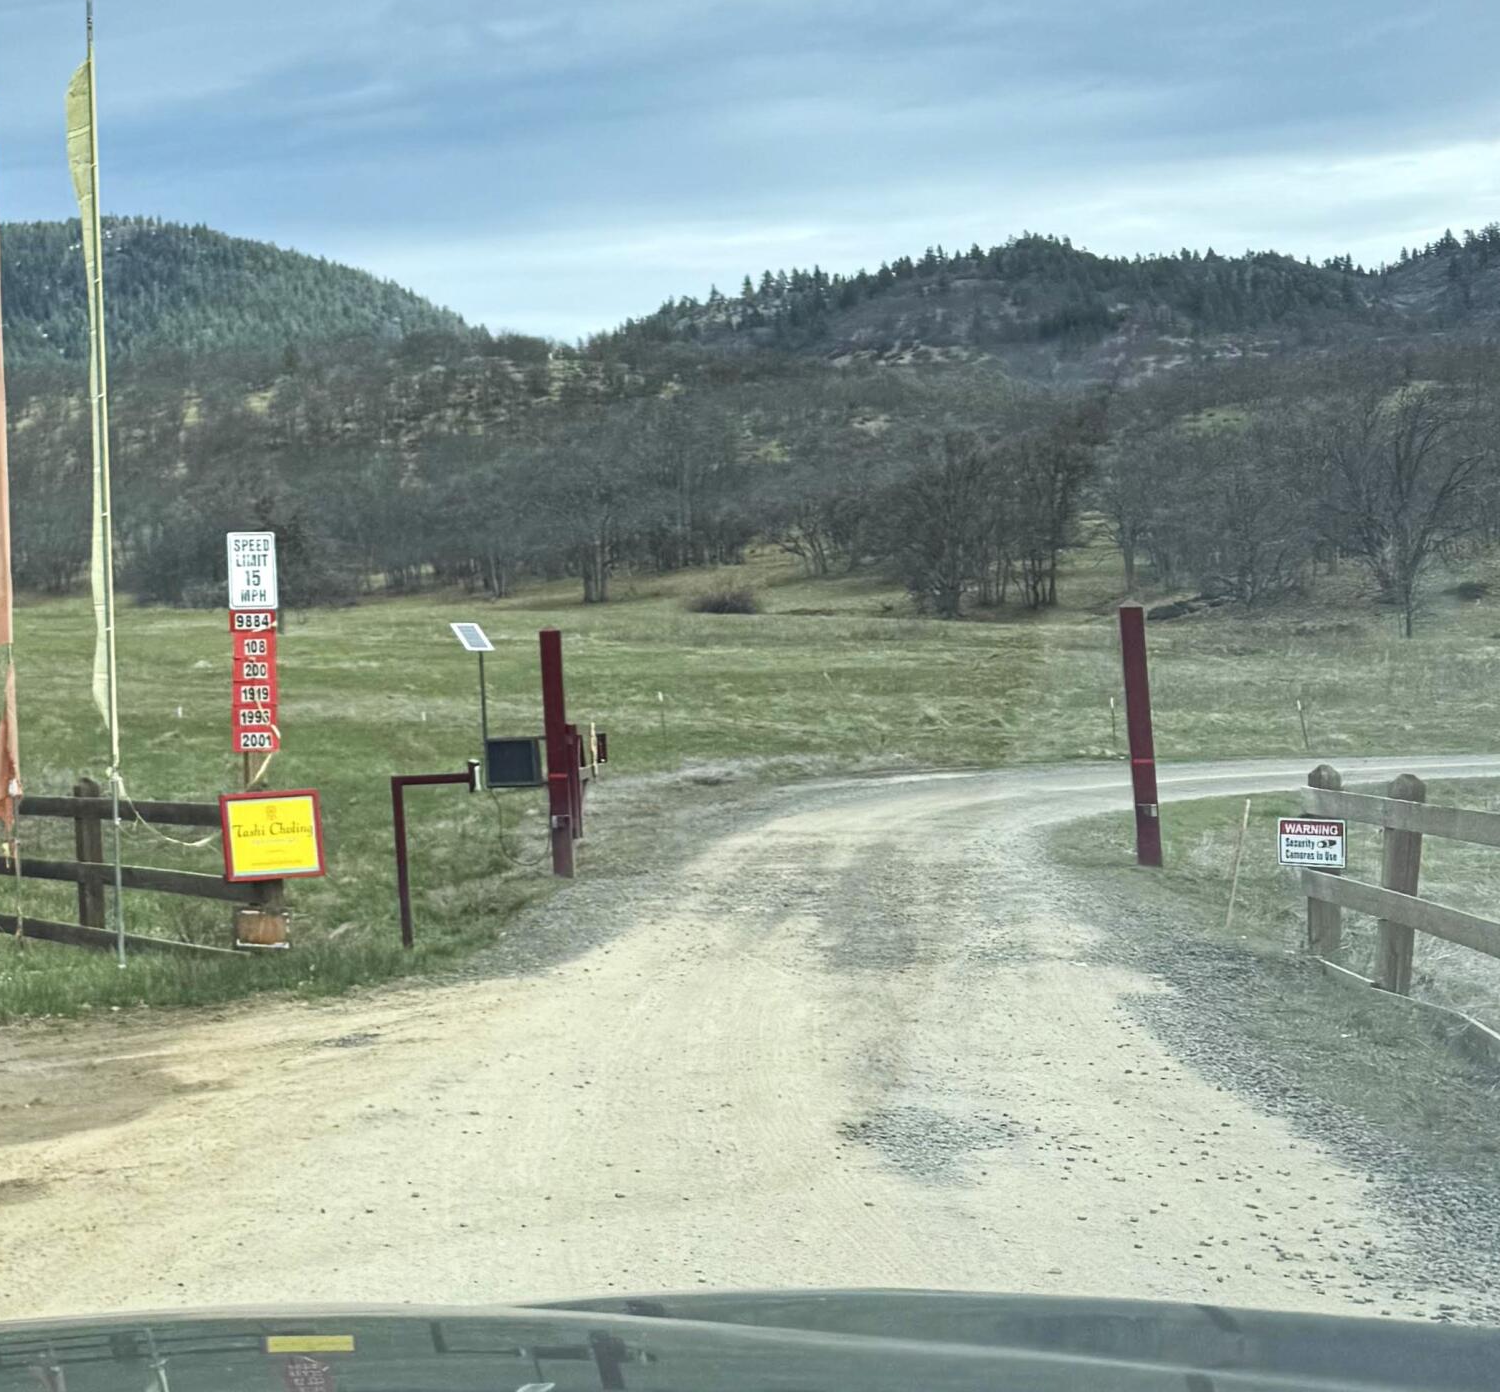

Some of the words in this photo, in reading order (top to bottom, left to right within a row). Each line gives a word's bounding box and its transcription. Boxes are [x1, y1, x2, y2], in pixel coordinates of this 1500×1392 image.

[233, 539, 270, 552] SPEED
[235, 554, 268, 567] LIMIT
[245, 570, 261, 586] 15
[241, 589, 267, 602] MPH
[236, 615, 269, 628] 9884
[245, 641, 266, 653] 108
[245, 664, 267, 677] 200
[242, 687, 269, 701] 1919
[242, 734, 272, 747] 2001
[232, 824, 265, 838] Tashi
[269, 821, 313, 837] Choling
[1284, 823, 1339, 835] WARNING
[1285, 837, 1315, 850] Security
[1285, 849, 1315, 860] Cameras
[1316, 851, 1323, 860] in
[1325, 851, 1337, 861] Use
